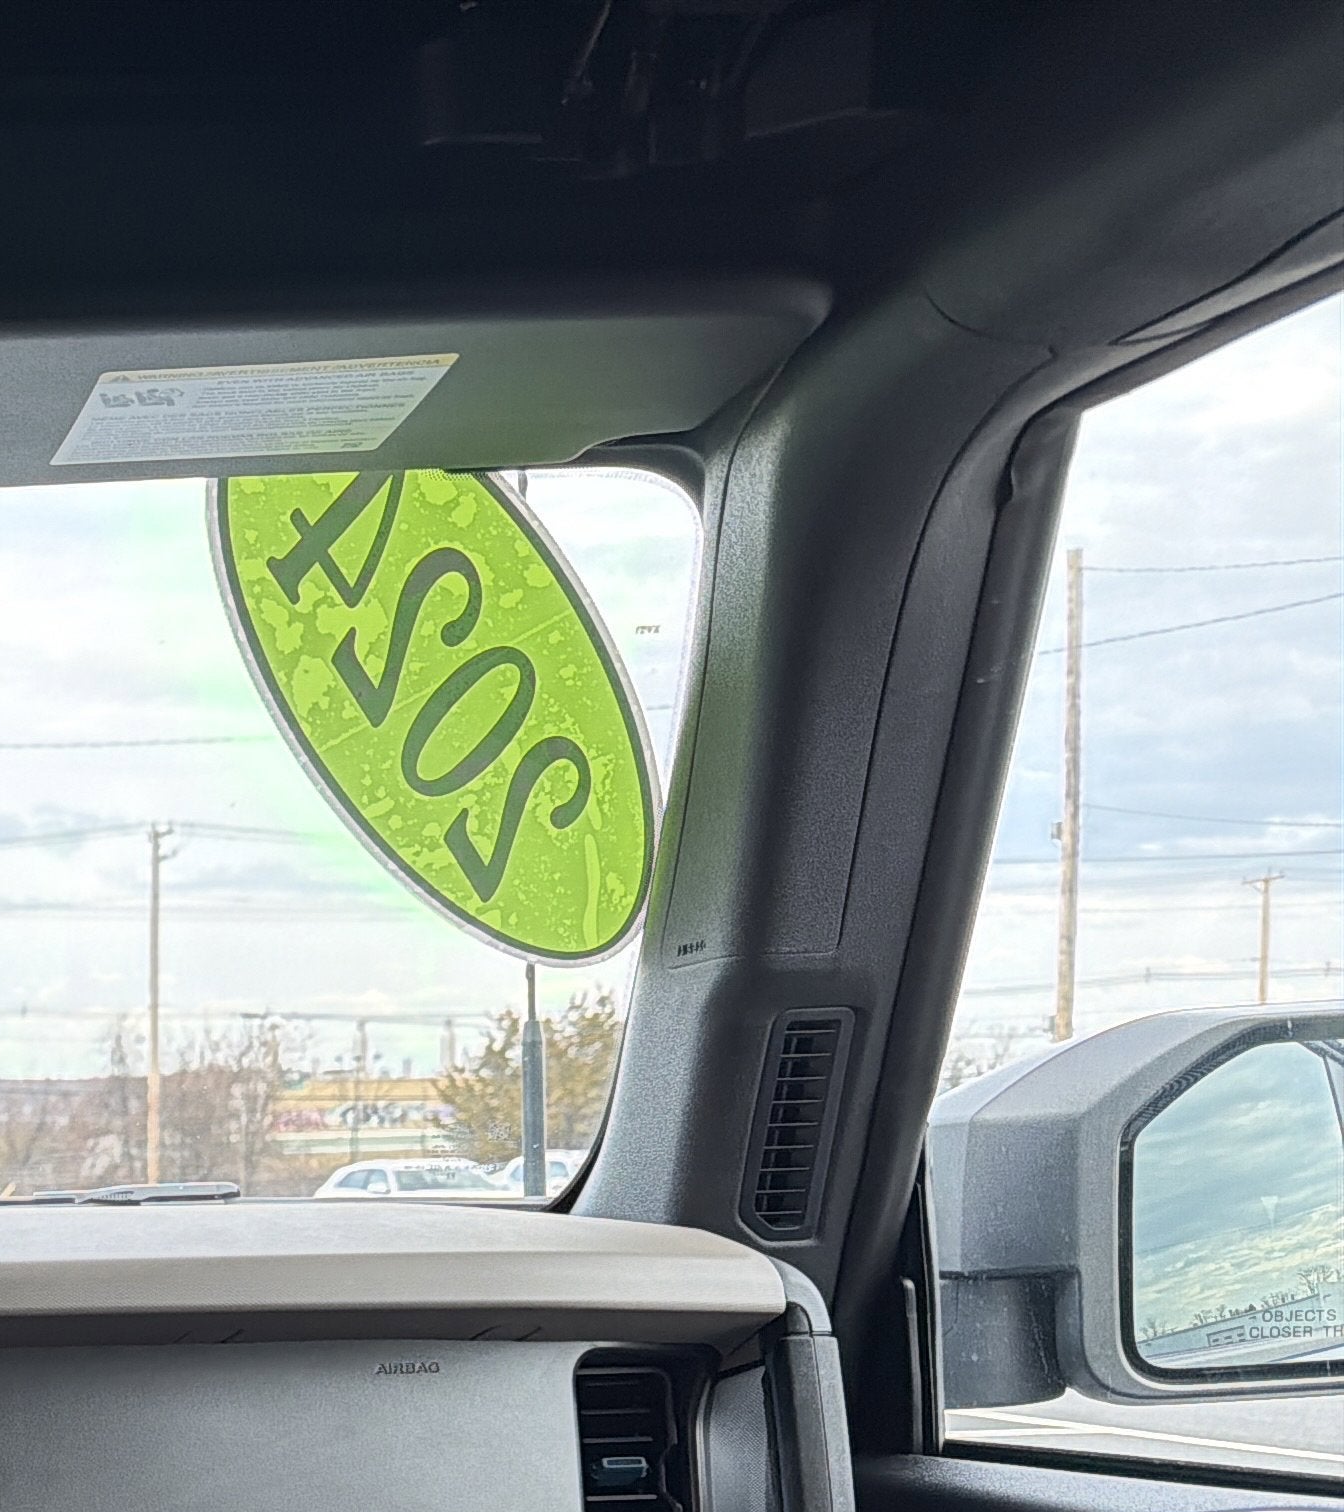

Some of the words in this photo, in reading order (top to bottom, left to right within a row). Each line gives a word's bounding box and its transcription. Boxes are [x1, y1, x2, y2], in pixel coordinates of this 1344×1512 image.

[1262, 1309, 1337, 1323] OBJECTS
[1249, 1326, 1313, 1339] CLOSER
[375, 1361, 440, 1374] AIRBAG
